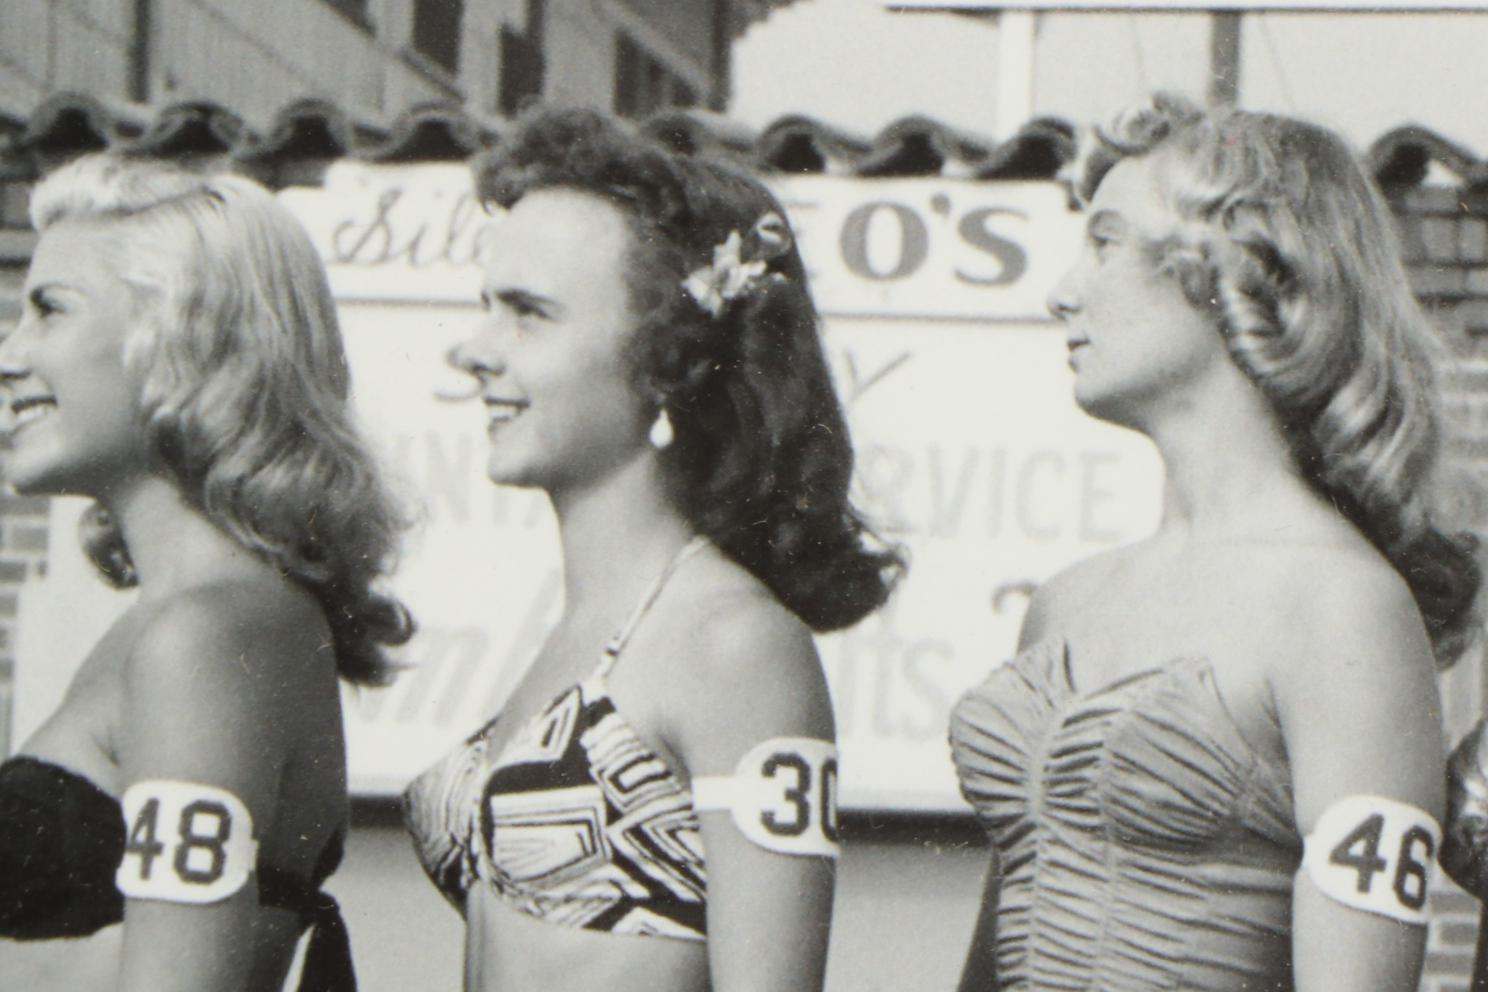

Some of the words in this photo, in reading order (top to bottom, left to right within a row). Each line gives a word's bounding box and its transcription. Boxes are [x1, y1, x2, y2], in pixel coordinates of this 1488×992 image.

[786, 189, 1032, 289] O'S
[123, 796, 232, 886] 48
[1329, 812, 1438, 912] 46
